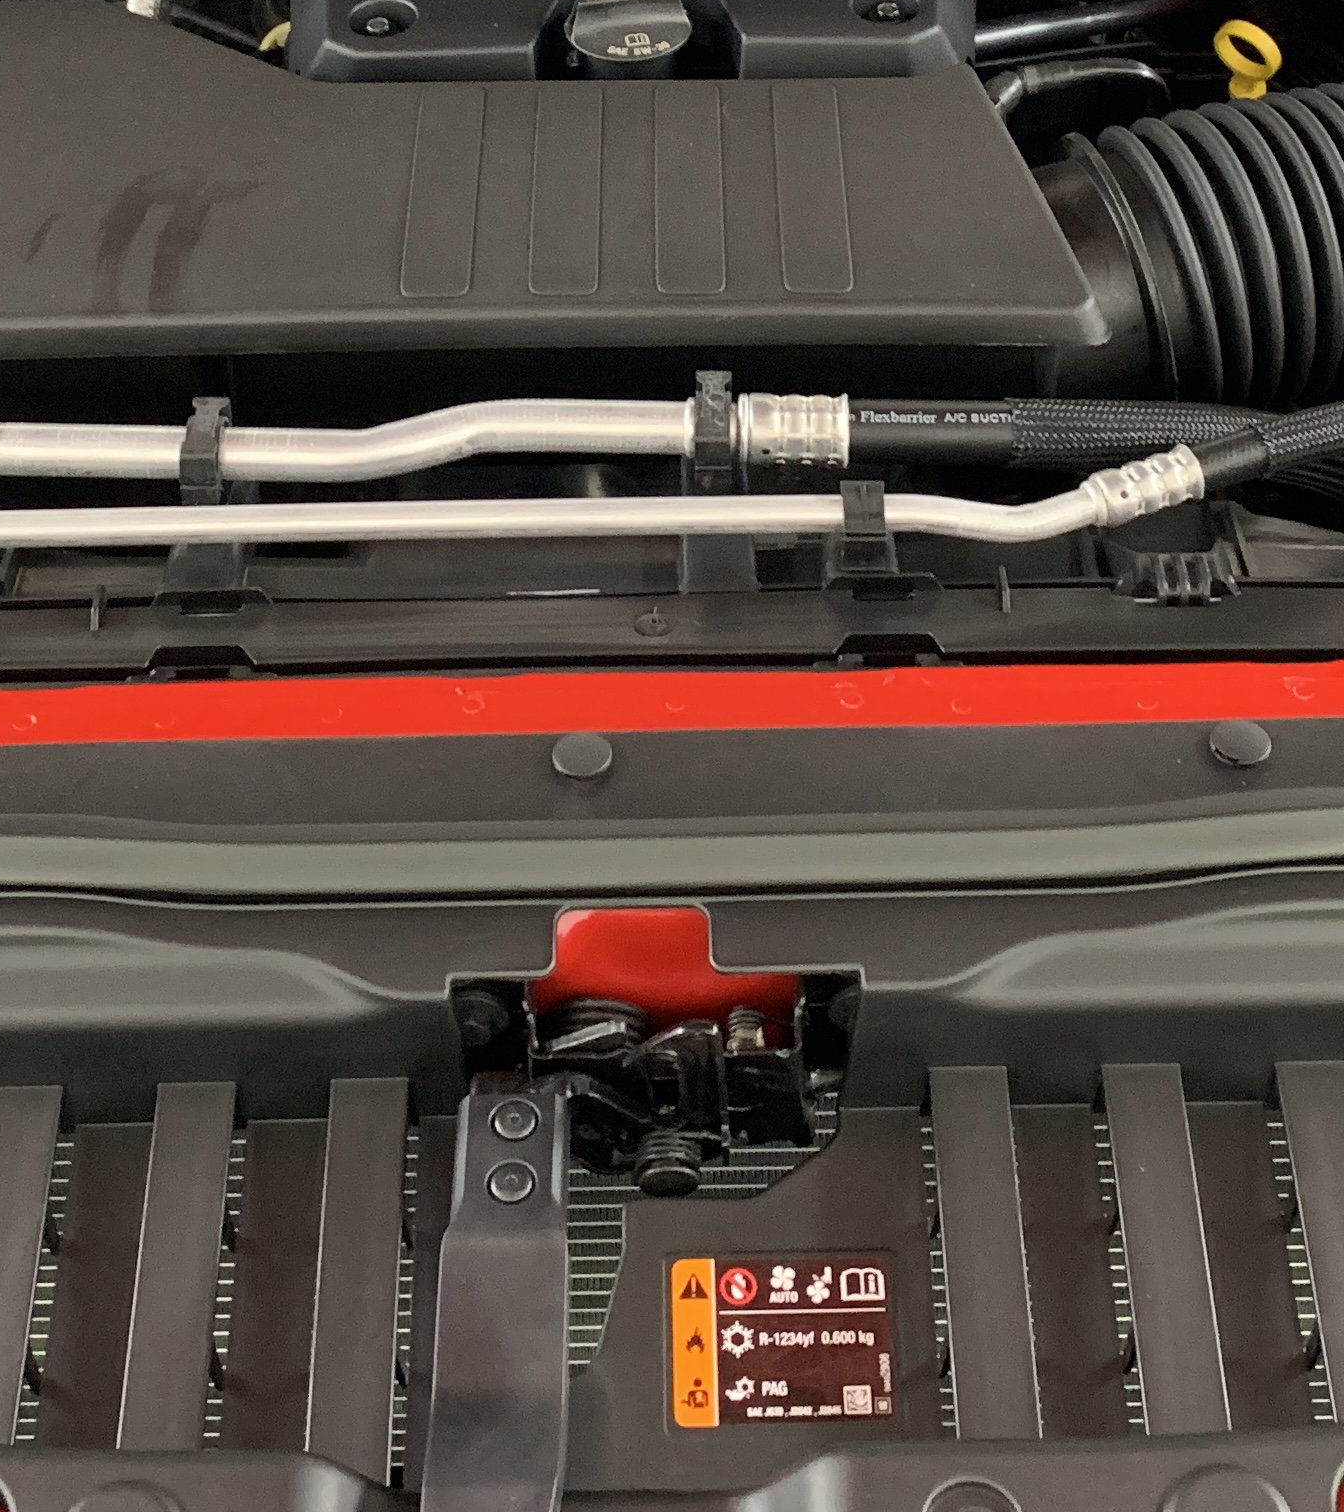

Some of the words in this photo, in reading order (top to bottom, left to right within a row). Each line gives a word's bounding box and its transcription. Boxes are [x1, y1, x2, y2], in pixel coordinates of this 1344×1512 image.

[860, 410, 937, 424] Flexbarrier
[943, 412, 967, 424] A/C
[769, 1291, 798, 1303] AUTO
[759, 1331, 814, 1347] R-1234yf
[820, 1331, 856, 1345] 0.600
[858, 1330, 875, 1346] kg
[762, 1381, 788, 1396] PAG
